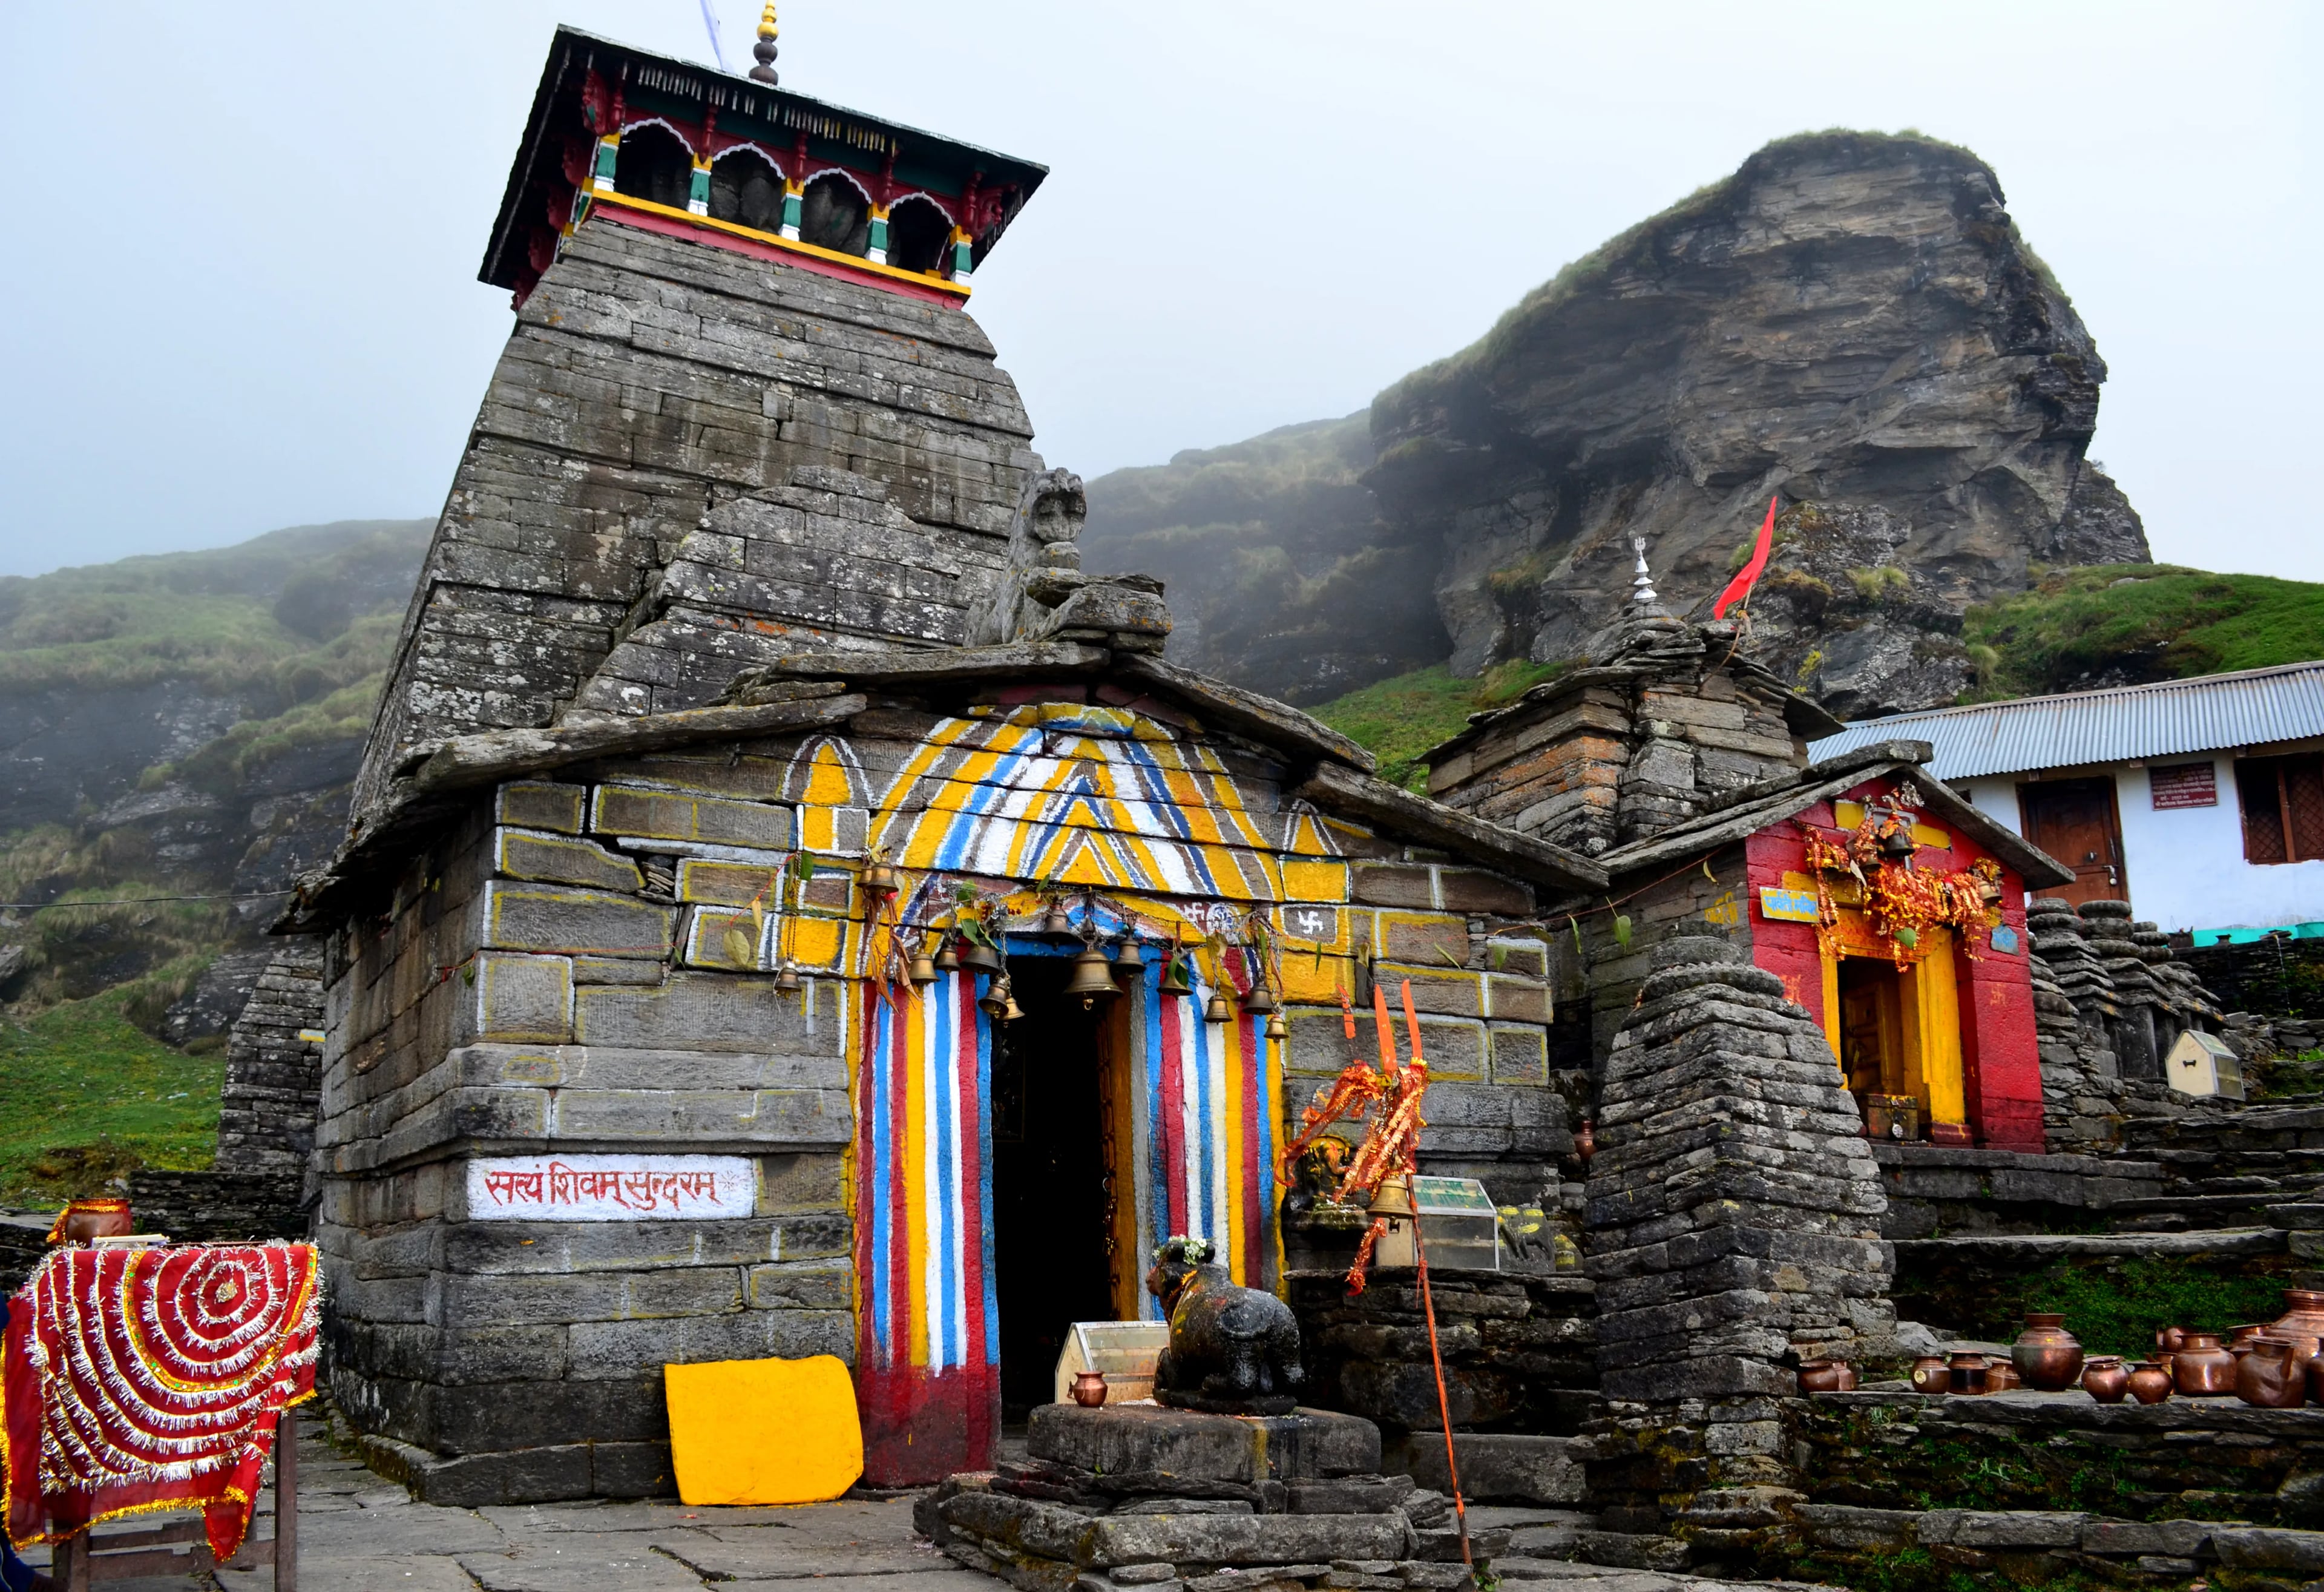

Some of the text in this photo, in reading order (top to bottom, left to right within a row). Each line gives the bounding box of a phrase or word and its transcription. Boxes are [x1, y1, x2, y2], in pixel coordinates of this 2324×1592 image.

[485, 1161, 723, 1210] सत्यं शिवम् सुन्दरम्
